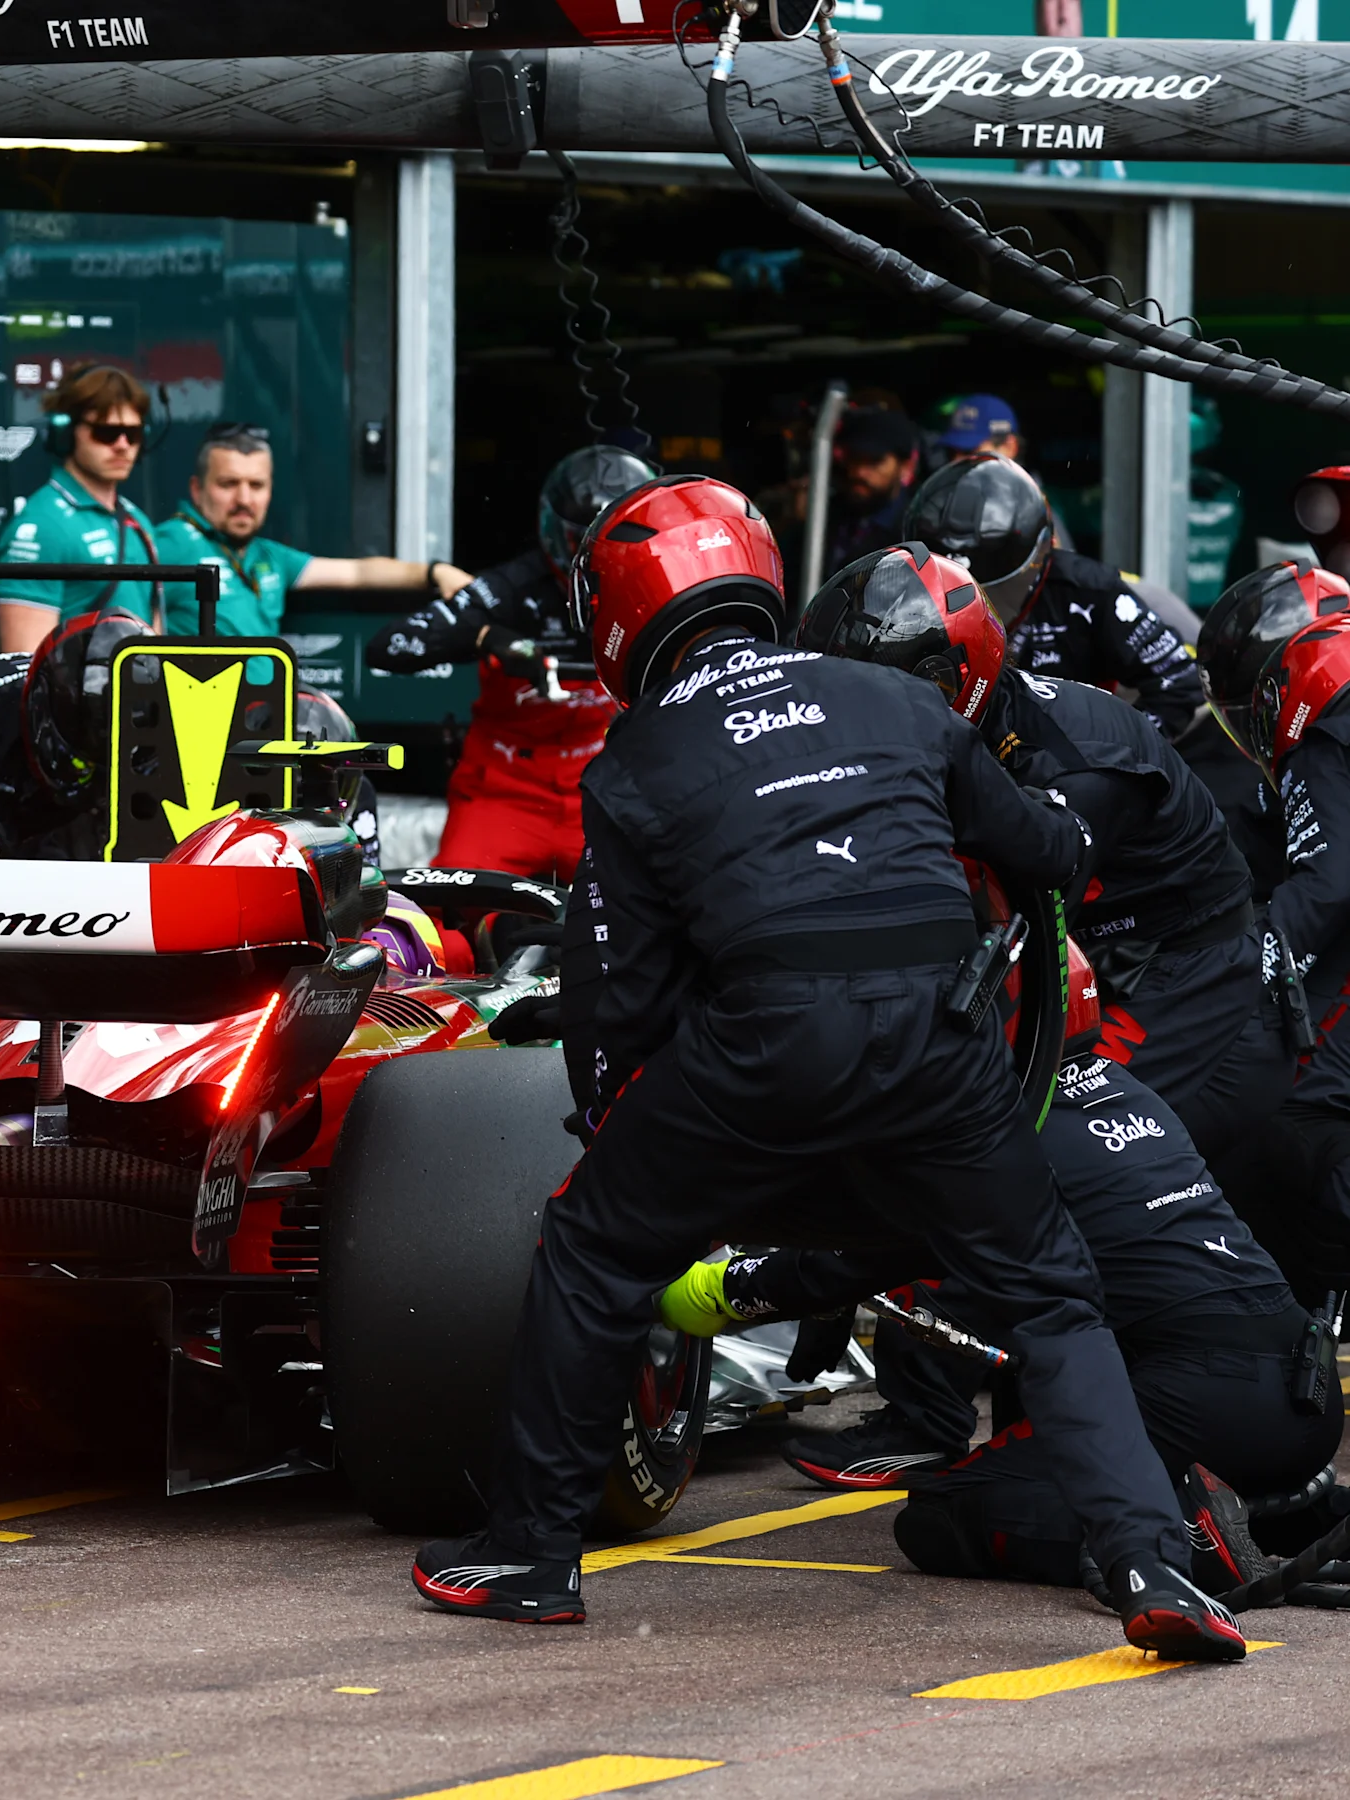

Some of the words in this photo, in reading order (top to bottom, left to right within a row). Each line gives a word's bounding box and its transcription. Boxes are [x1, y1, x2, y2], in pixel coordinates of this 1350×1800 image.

[48, 20, 74, 48] F1
[78, 17, 148, 47] TEAM
[868, 49, 1012, 117] Alfa
[1011, 46, 1221, 100] Romeo
[974, 124, 1006, 147] F1
[1017, 124, 1104, 149] TEAM
[604, 621, 621, 658] MASCOT
[659, 664, 727, 707] Alfa
[726, 649, 823, 675] Romeo
[715, 683, 737, 697] F1
[737, 668, 785, 690] TEAM
[963, 677, 983, 717] MASCOT
[967, 679, 988, 718] WORKWEAR
[724, 701, 827, 744] Stake
[1287, 701, 1307, 739] MASCOT
[1293, 705, 1311, 741] WORKWEAR
[755, 772, 819, 797] sensetime
[401, 868, 476, 885] Stake
[1091, 916, 1136, 937] CREW
[1064, 1087, 1081, 1099] F1
[1080, 1074, 1110, 1094] TEAM
[1088, 1113, 1165, 1152] Stake
[195, 1174, 236, 1217] SINGHA
[1146, 1188, 1188, 1210] sensetime
